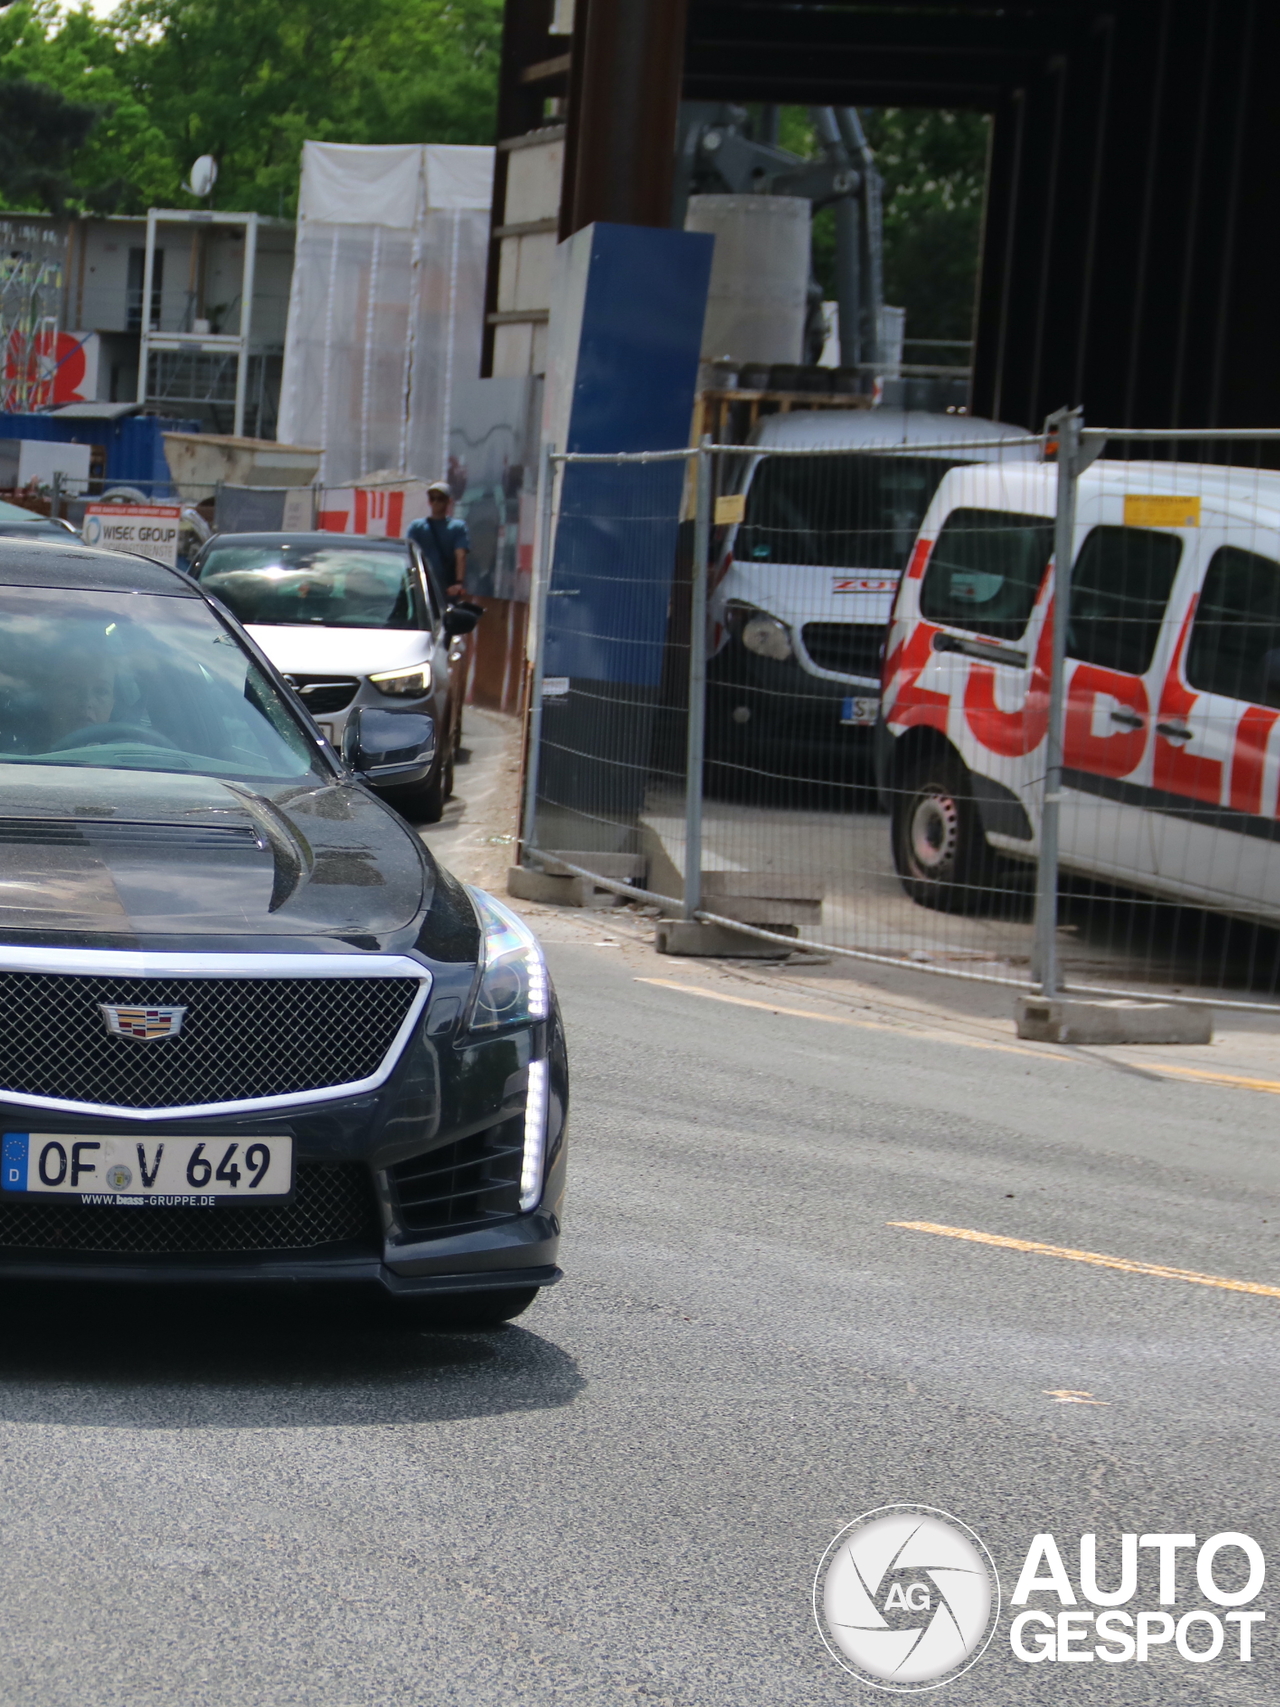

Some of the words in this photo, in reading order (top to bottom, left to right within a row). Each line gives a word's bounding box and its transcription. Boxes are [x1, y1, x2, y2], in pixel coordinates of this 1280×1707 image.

[103, 525, 135, 541] WISEC
[138, 527, 176, 543] GROUP
[38, 1141, 101, 1187] OF
[135, 1142, 165, 1188] V
[186, 1143, 270, 1188] 649
[9, 1168, 19, 1182] D
